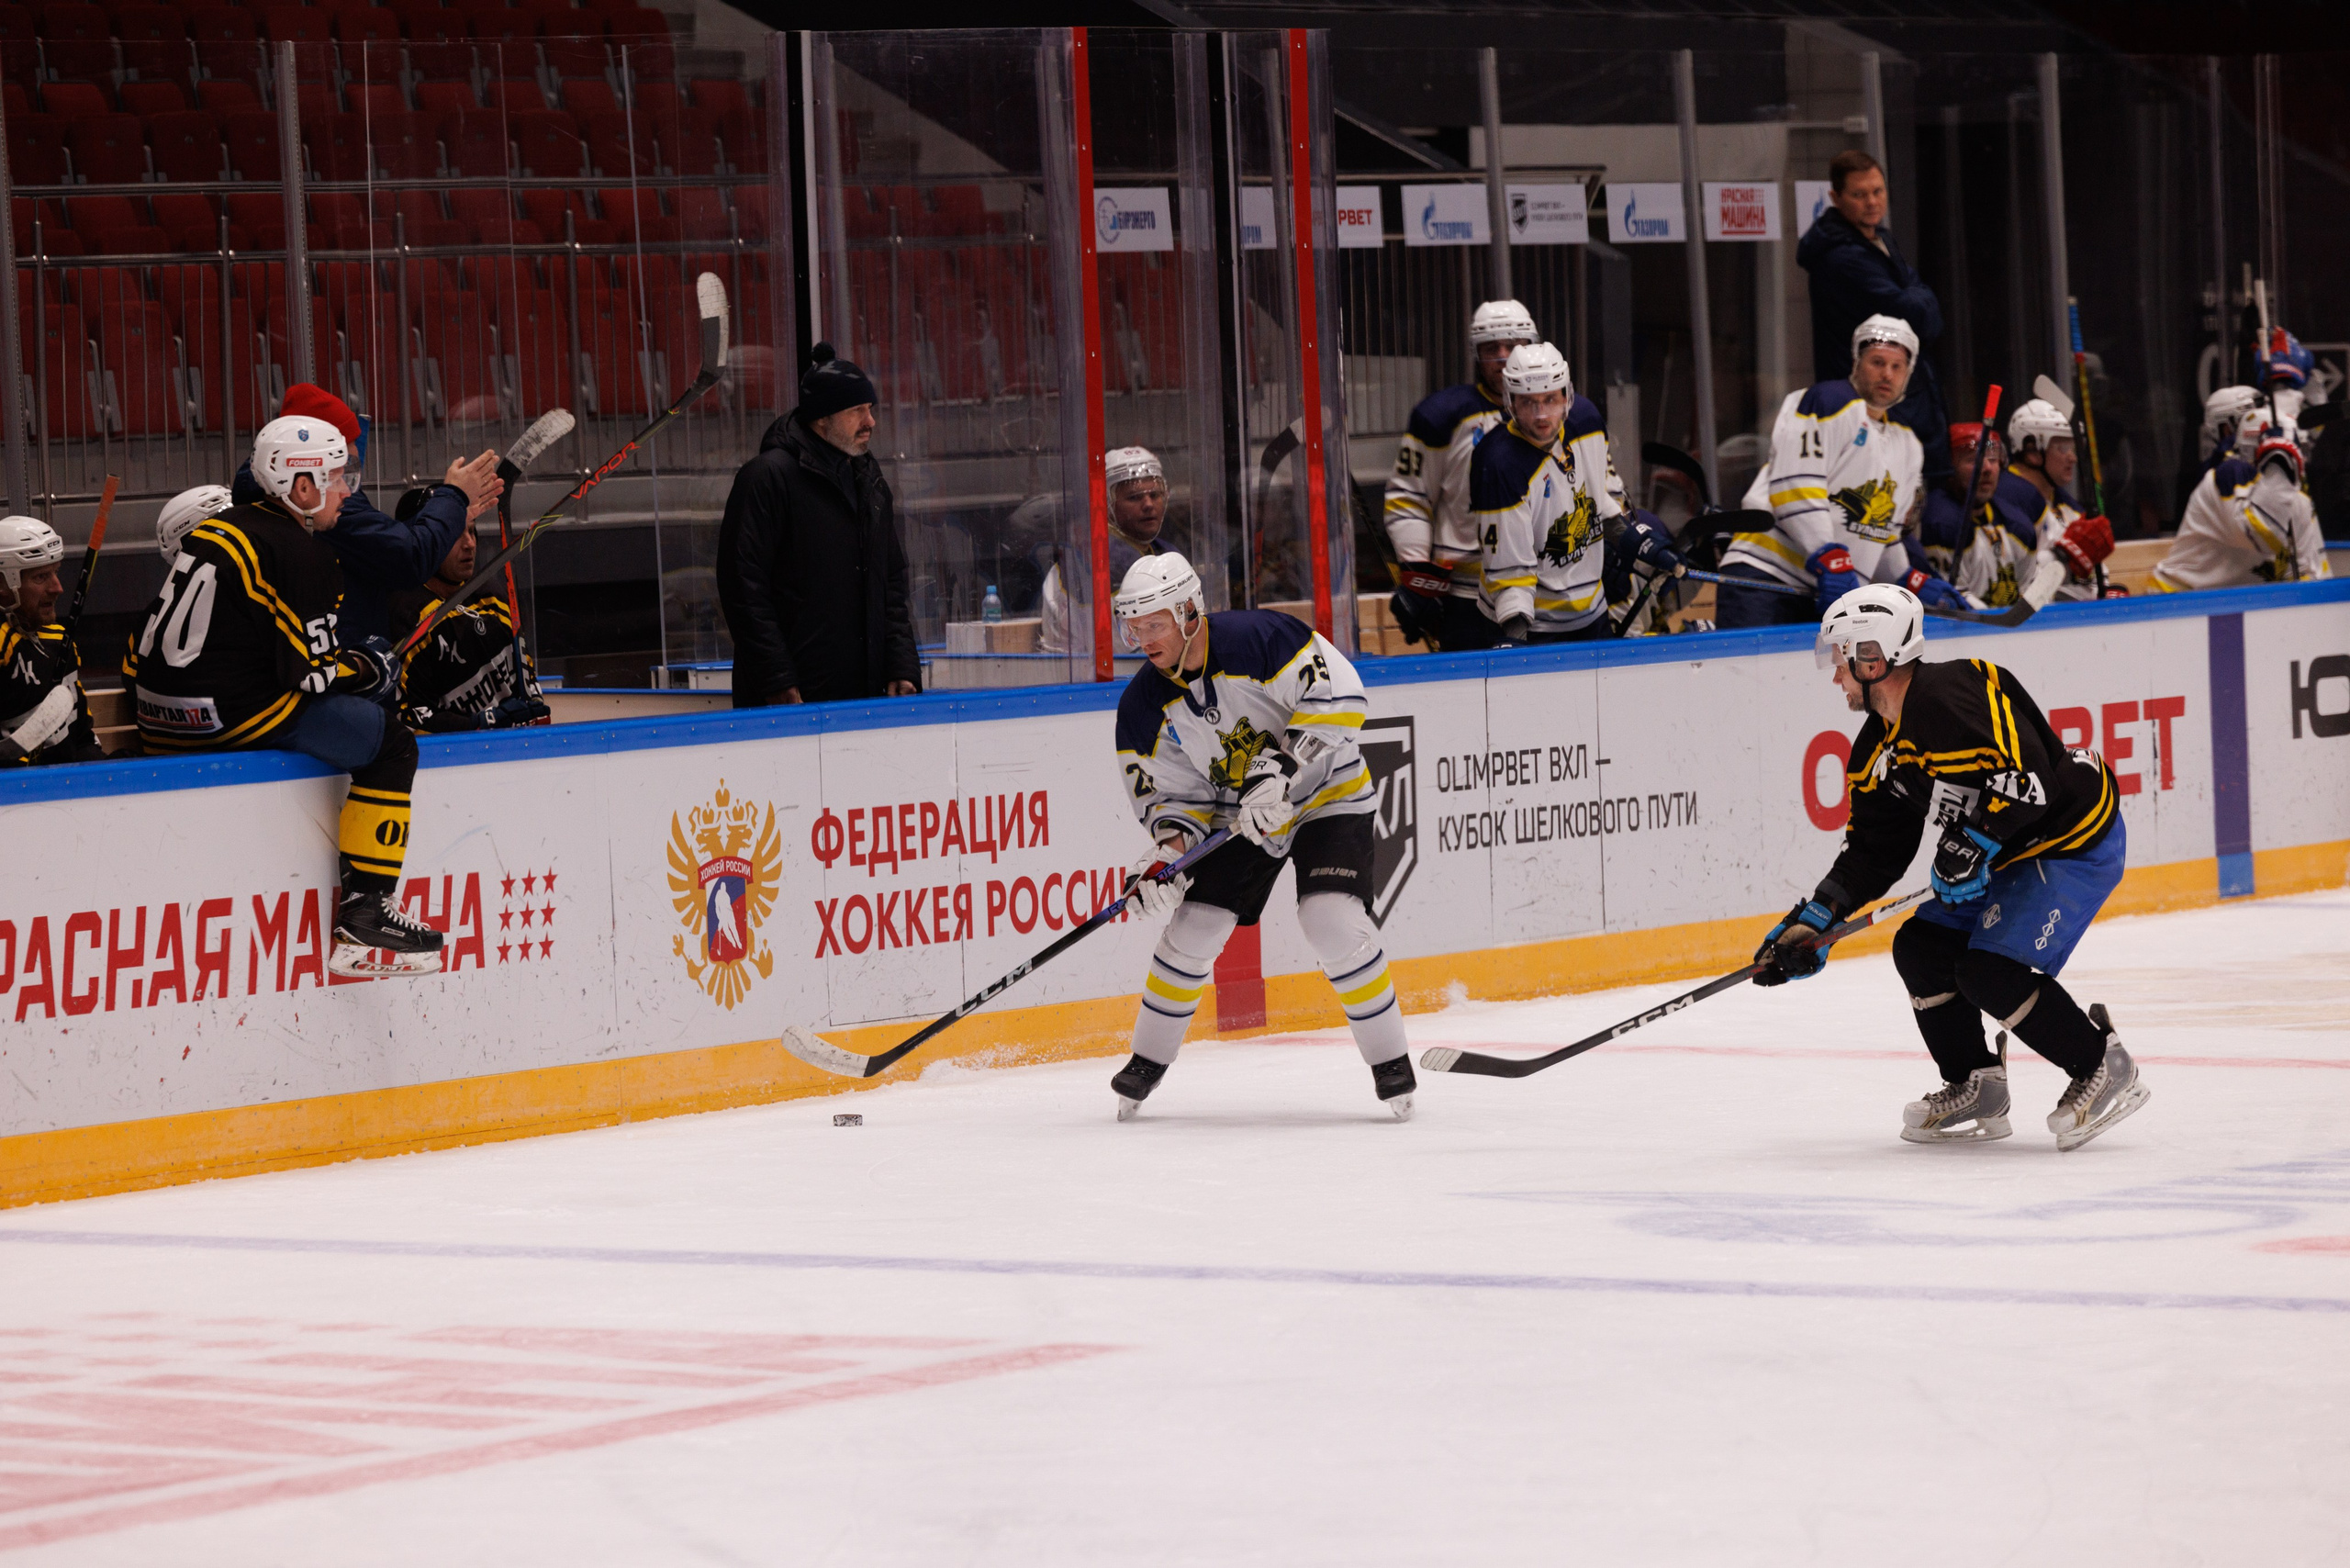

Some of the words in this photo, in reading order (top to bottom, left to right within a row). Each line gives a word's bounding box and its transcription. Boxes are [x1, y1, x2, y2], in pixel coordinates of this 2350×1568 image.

[1721, 206, 1765, 228] МАШИНА
[570, 441, 641, 499] VAPOR
[1438, 748, 1541, 793] OLIMPBET
[1550, 744, 1587, 781] ВХЛ
[811, 790, 1049, 877] ФЕДЕРАЦИЯ
[1438, 810, 1506, 852] КУБОК
[1516, 797, 1639, 844] ШЕЛКОВОГО
[1648, 791, 1697, 829] ПУТИ
[700, 859, 725, 882] ХОККЕЙ
[726, 860, 751, 877] РОССИИ
[1310, 868, 1358, 878] BAUER
[814, 883, 973, 958] ХОККЕЯ
[1612, 994, 1695, 1038] CCM
